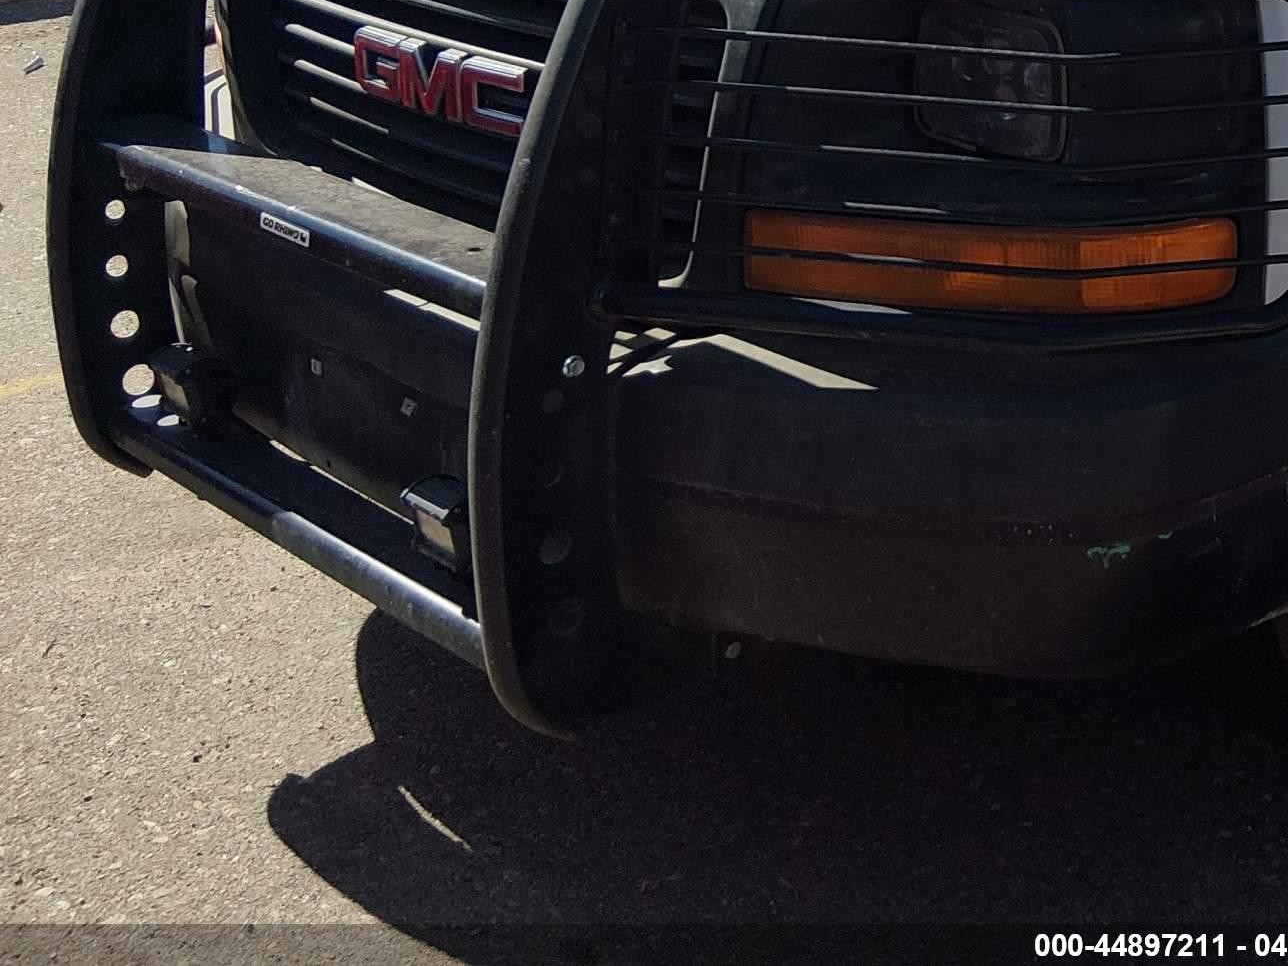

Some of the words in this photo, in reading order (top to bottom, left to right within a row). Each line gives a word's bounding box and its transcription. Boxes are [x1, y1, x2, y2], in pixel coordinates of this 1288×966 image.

[354, 25, 529, 137] GMC
[262, 217, 274, 228] GO
[274, 222, 299, 240] RHINO
